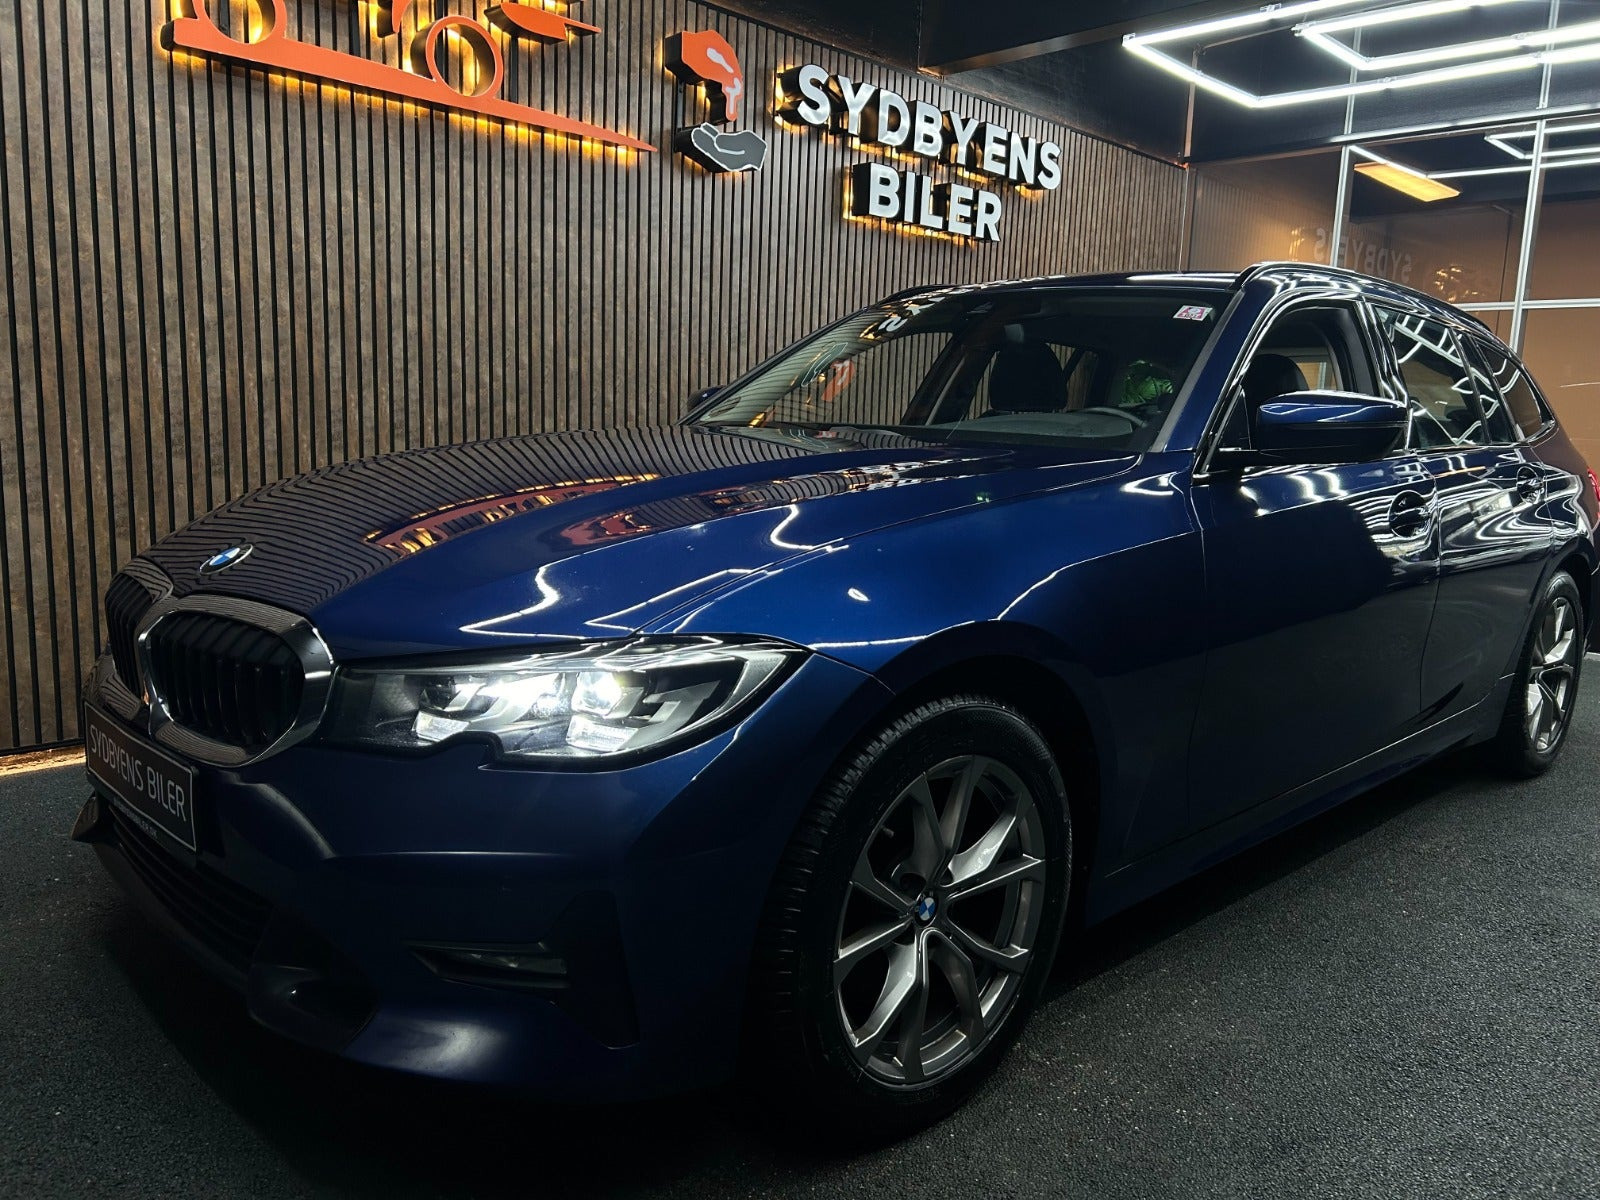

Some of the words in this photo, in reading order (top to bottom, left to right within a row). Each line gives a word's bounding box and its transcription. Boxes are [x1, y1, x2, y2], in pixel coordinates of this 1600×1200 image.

[797, 63, 1062, 190] SYDBYENS
[868, 162, 1002, 242] BILER
[89, 724, 144, 792] SYDBYENS
[146, 766, 187, 822] BILER
